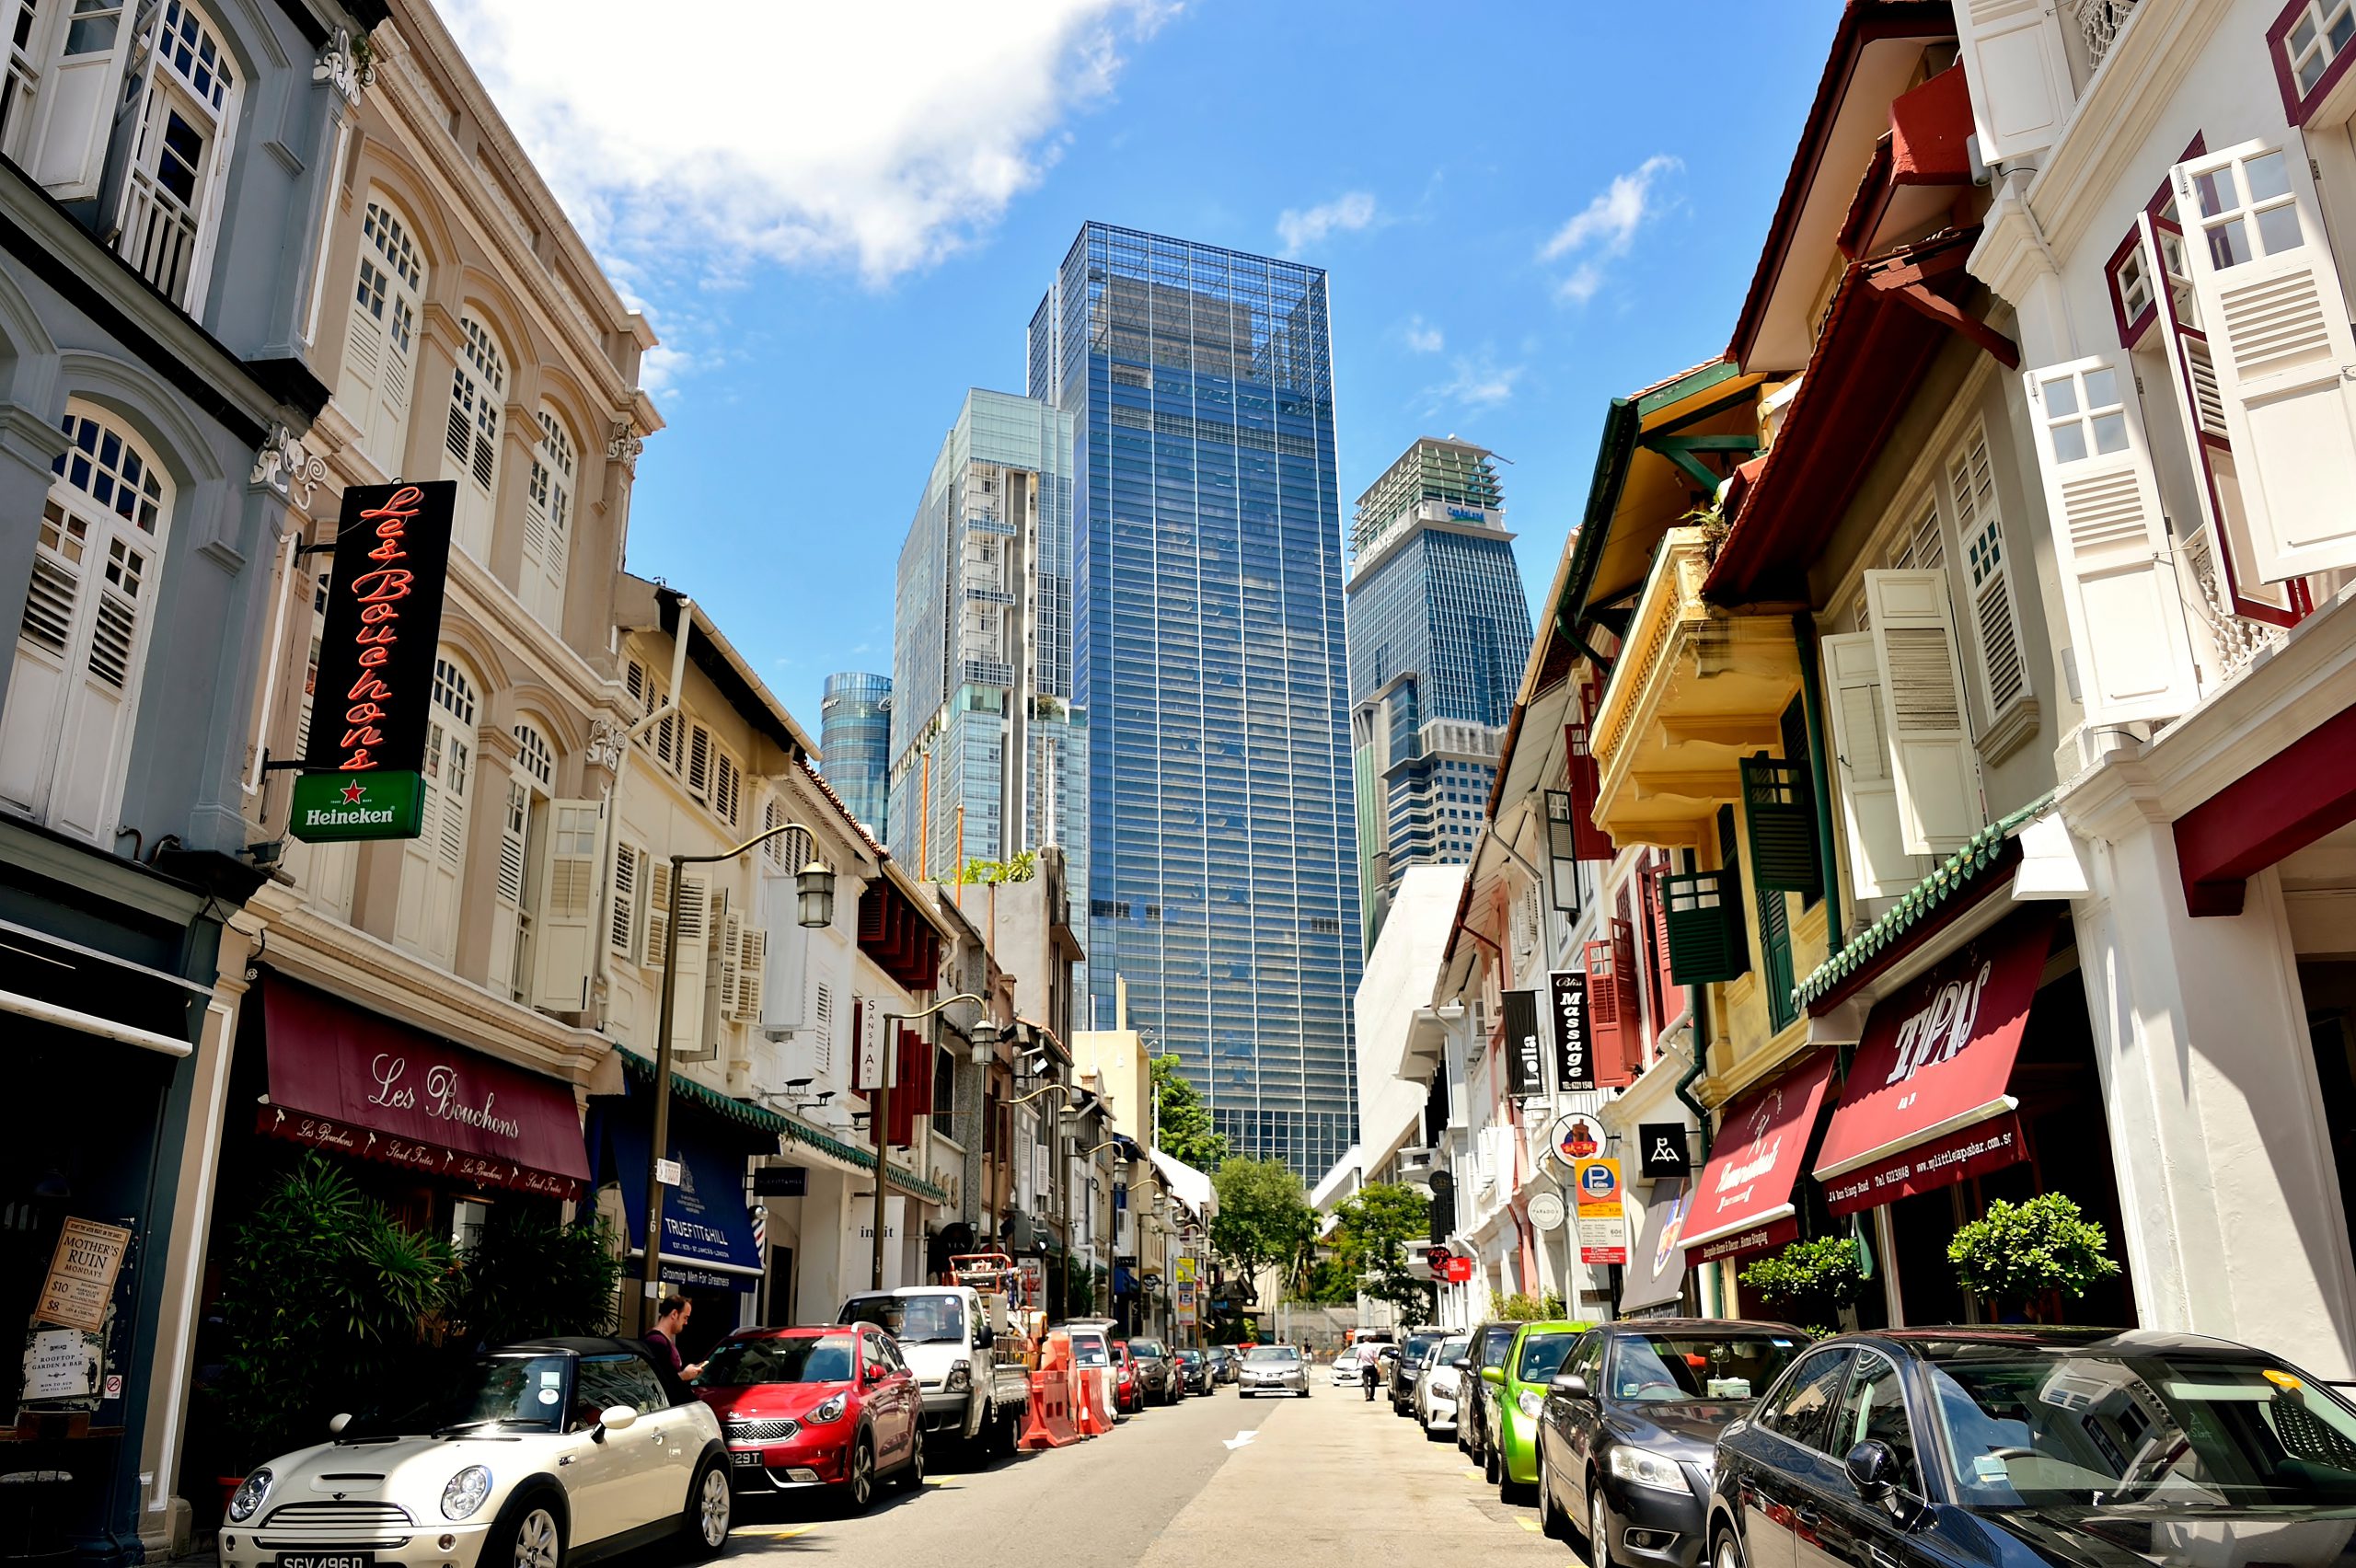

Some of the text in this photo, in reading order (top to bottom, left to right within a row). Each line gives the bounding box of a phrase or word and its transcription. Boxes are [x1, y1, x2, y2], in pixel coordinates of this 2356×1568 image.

[338, 486, 422, 770] Les Bouchons
[306, 807, 393, 825] Heineken
[1556, 977, 1582, 987] Bliss
[1560, 992, 1583, 1078] Massage
[865, 1054, 874, 1083] ART
[1521, 1035, 1540, 1086] Lolla
[368, 1054, 519, 1138] Les Bouchons
[296, 1119, 353, 1147] Les Bouchons
[474, 1160, 502, 1181] Bouchons
[1875, 1174, 1885, 1187] Tel
[67, 1249, 108, 1269] RUIN
[64, 1264, 103, 1278] MONDAYS
[663, 1267, 730, 1287] Grooming Men For Greatness
[40, 1355, 75, 1363] ROOFTOP
[752, 1453, 759, 1464] T
